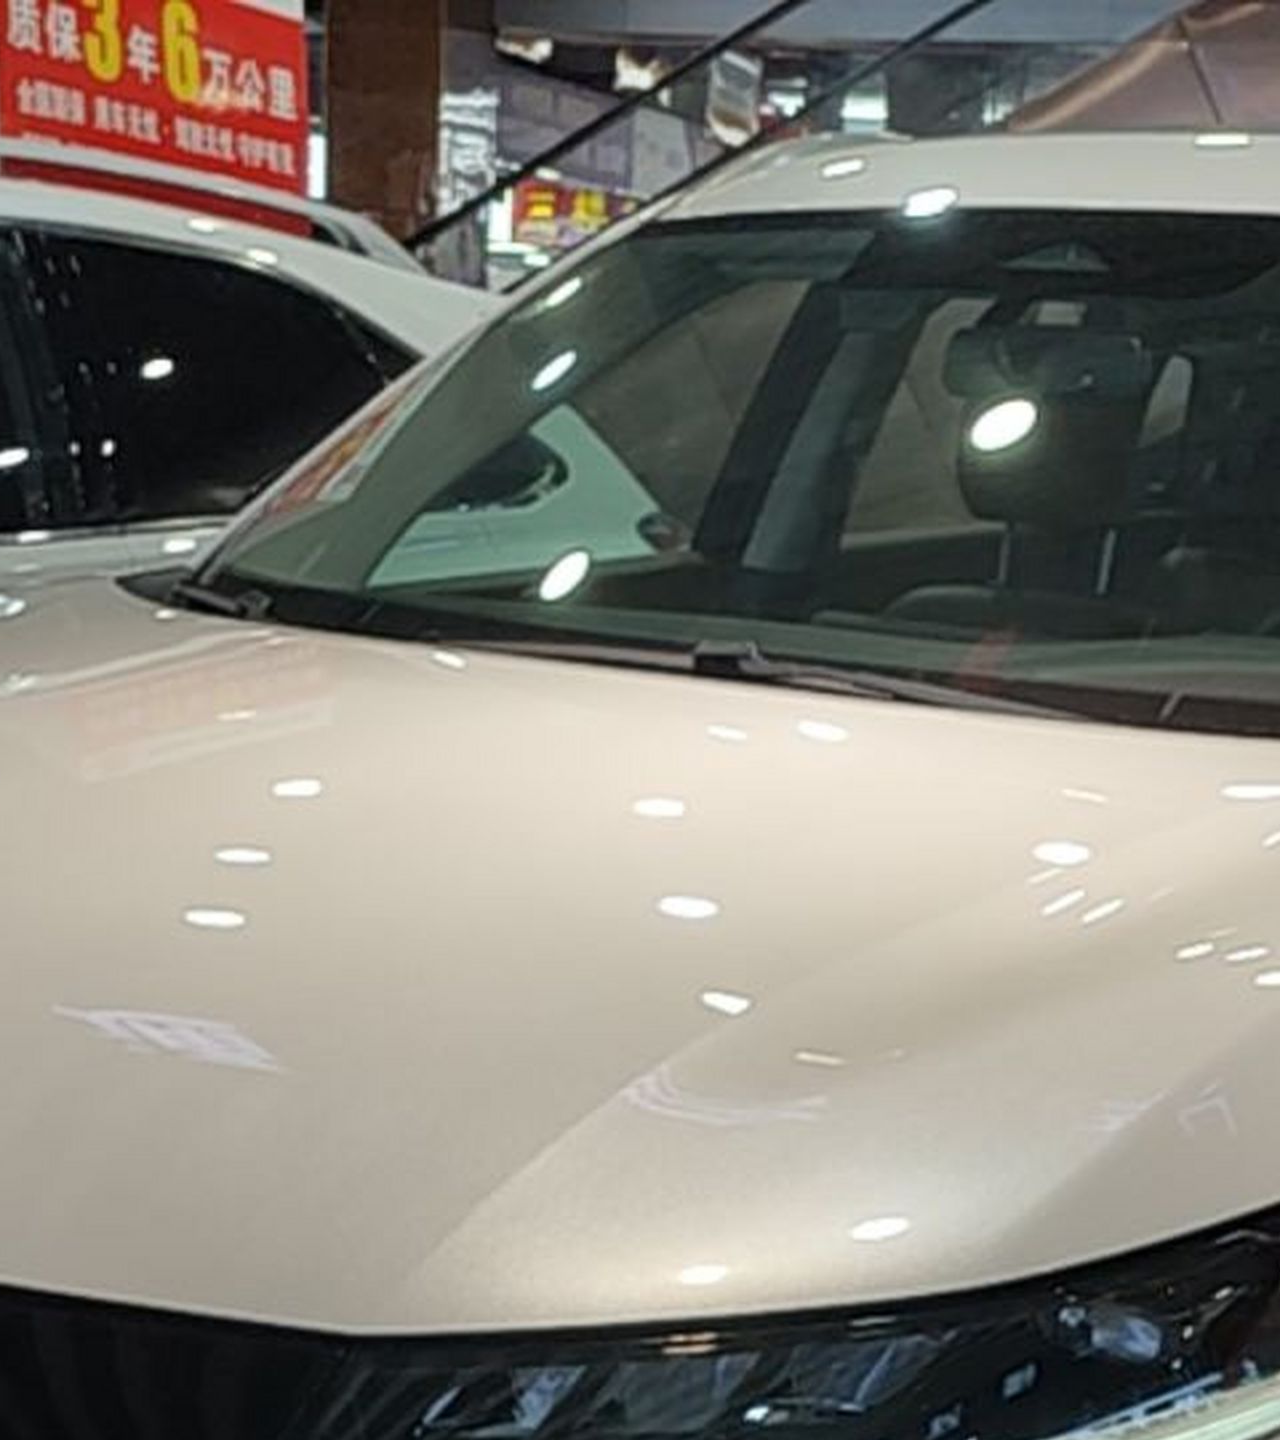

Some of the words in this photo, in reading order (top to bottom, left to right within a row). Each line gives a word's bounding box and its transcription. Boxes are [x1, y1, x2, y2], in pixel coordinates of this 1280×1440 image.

[8, 0, 298, 120] 质保3年6万公里
